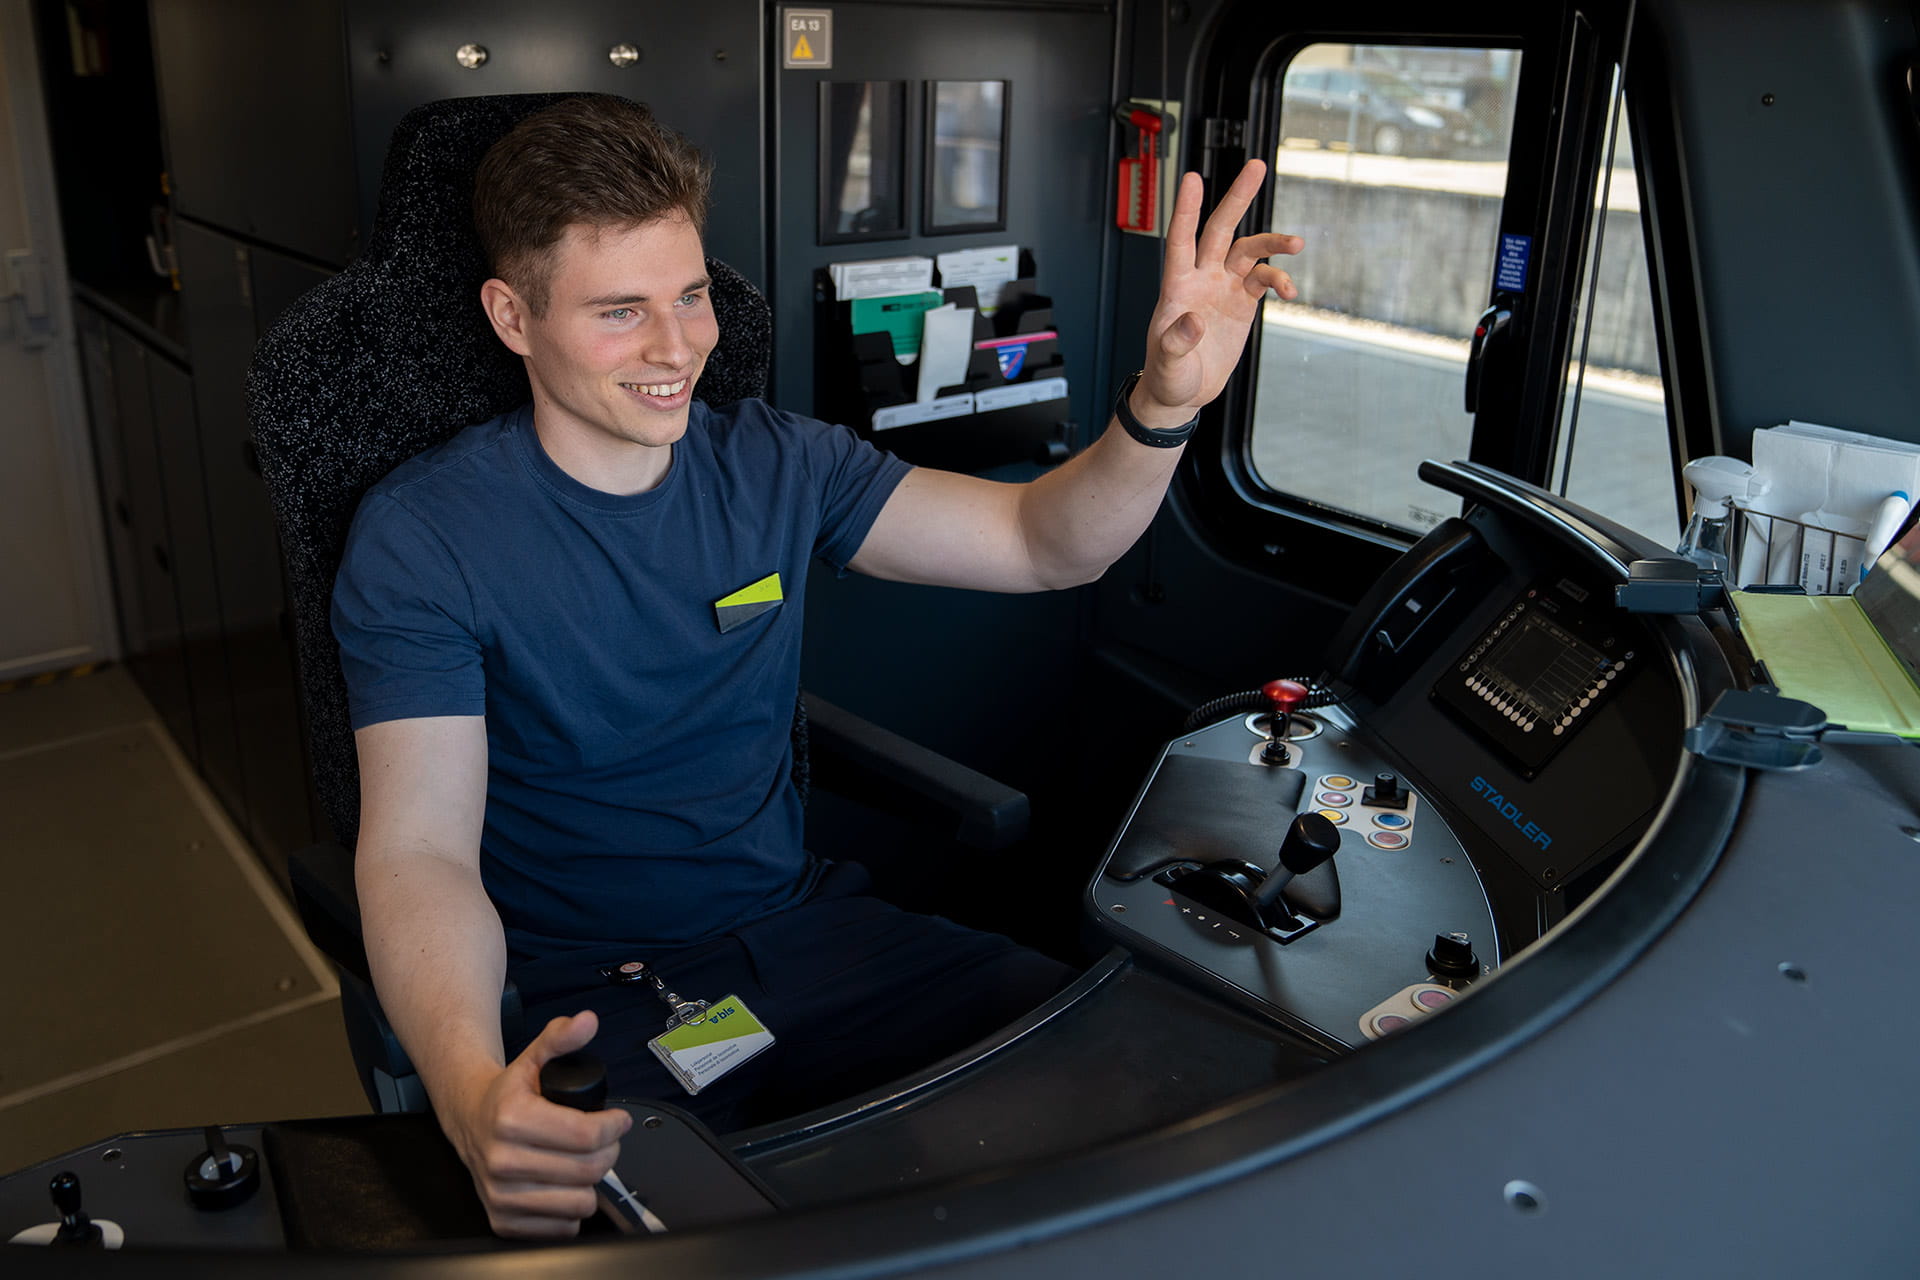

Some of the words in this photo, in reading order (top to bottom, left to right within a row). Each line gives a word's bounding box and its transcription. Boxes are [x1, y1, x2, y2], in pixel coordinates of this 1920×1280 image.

[791, 19, 807, 31] EA
[808, 20, 821, 32] 13
[1470, 776, 1553, 851] STADLER
[717, 1006, 735, 1019] bls
